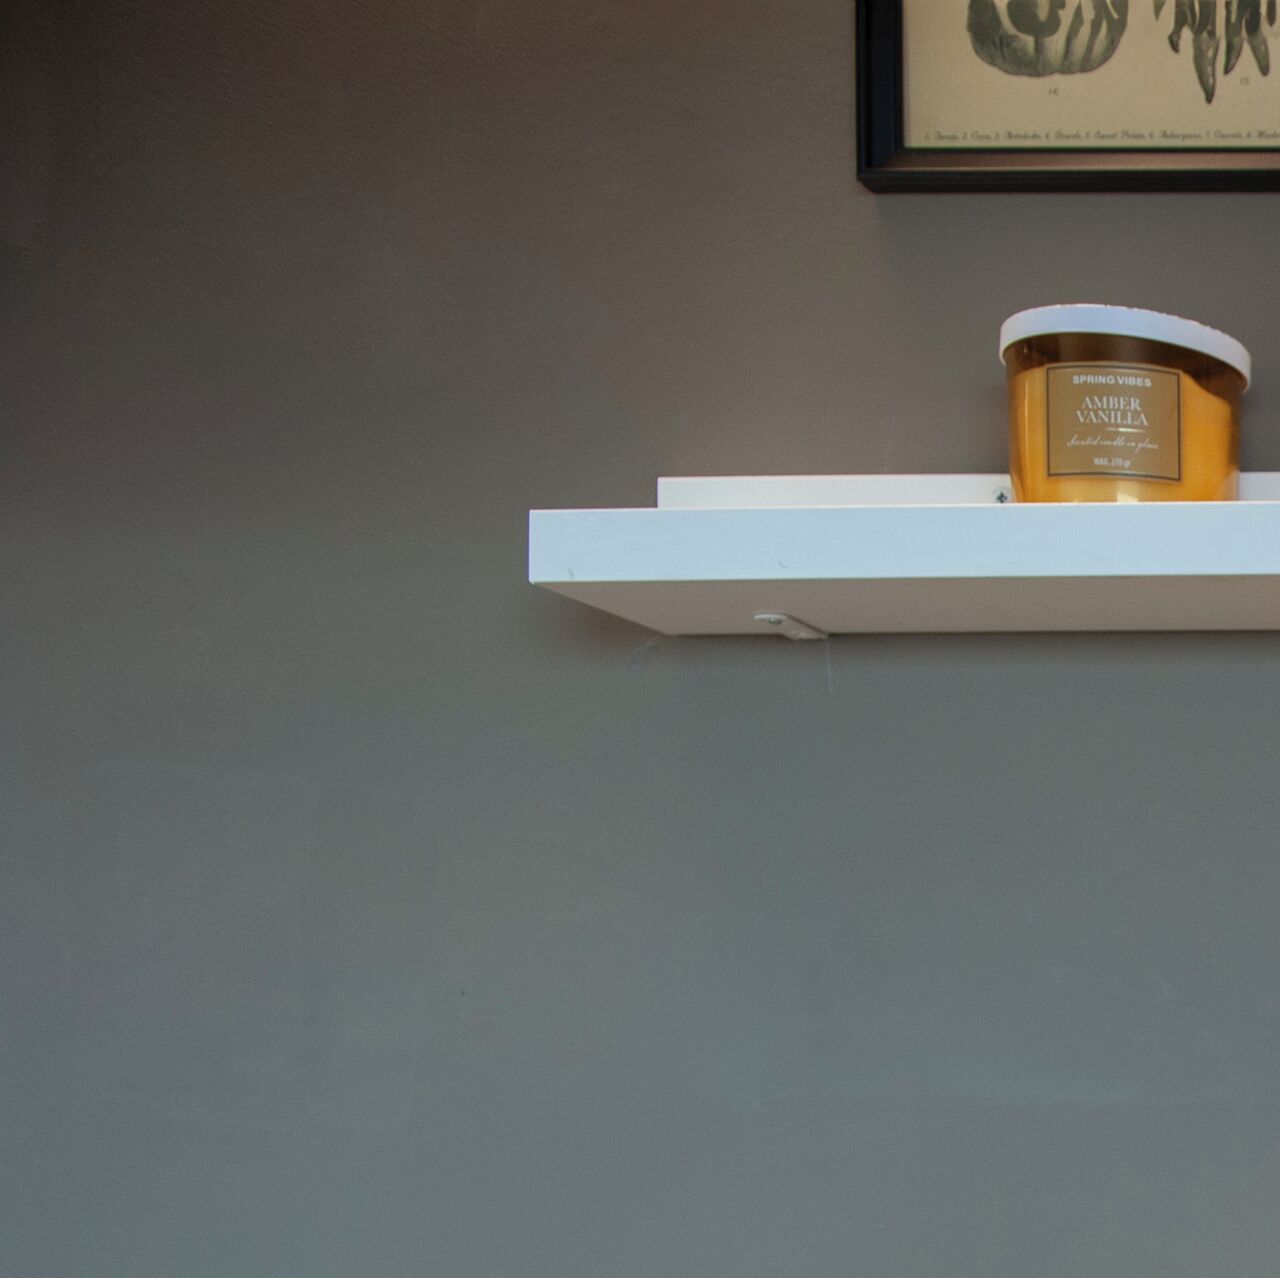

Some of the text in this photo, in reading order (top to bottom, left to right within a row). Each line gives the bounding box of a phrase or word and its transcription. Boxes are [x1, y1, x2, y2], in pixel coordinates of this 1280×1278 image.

[1072, 374, 1152, 387] SPRING VIBES
[1082, 396, 1142, 411] AMBER
[1076, 410, 1149, 426] VANILLA
